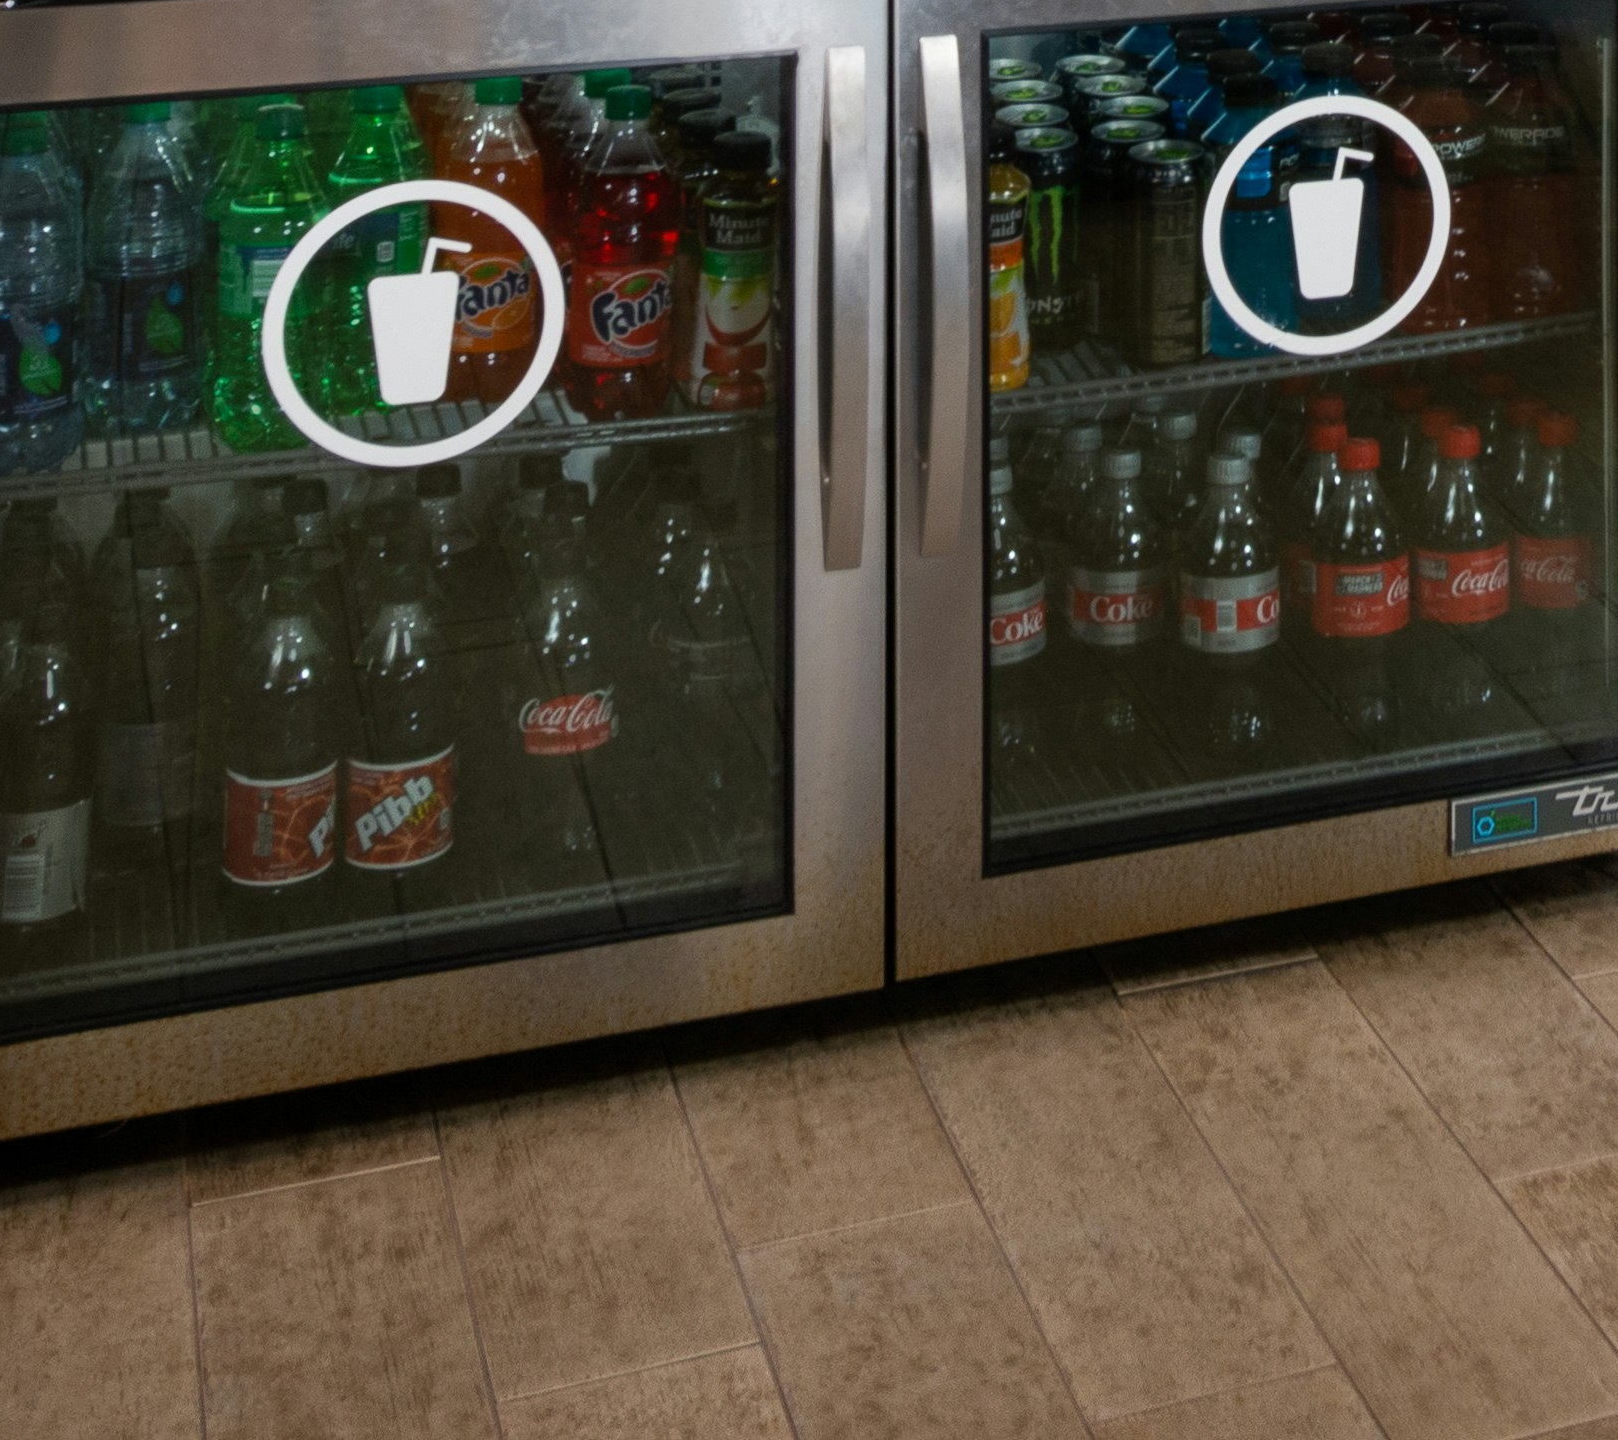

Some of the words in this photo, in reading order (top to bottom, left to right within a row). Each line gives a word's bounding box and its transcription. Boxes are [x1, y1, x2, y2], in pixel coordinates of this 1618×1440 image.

[989, 206, 1027, 225] nute
[989, 221, 1019, 238] aid
[591, 278, 673, 342] Fanta
[1088, 594, 1154, 624] Coke
[990, 609, 1044, 646] Coke
[352, 774, 434, 852] Pibb
